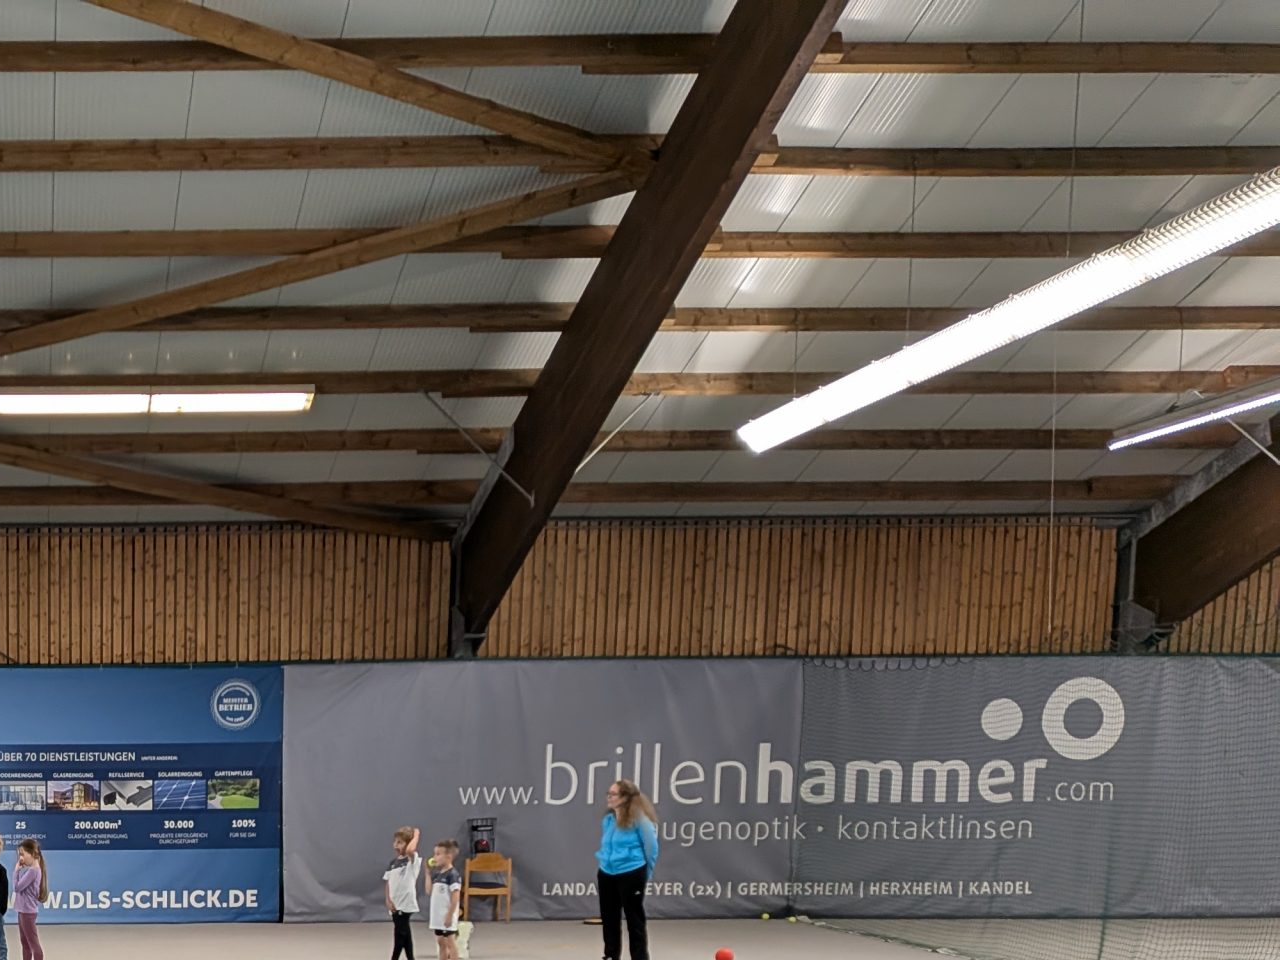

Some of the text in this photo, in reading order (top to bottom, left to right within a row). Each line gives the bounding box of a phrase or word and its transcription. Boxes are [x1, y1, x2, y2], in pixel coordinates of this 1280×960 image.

[25, 752, 37, 762] 70
[39, 751, 136, 762] DIENSTLEISTUNGEN
[15, 821, 27, 830] 25
[163, 820, 194, 829] 30.000
[231, 819, 257, 828] 100%
[657, 814, 808, 848] ugenoptik
[837, 813, 1034, 841] kontaktlinsen
[542, 882, 598, 896] LANDA
[644, 882, 683, 896] EYER
[688, 882, 721, 899] (2x)
[737, 881, 854, 896] GERMERSHEIM
[870, 881, 953, 895] HERXHEIM
[969, 881, 1033, 895] KANDEL
